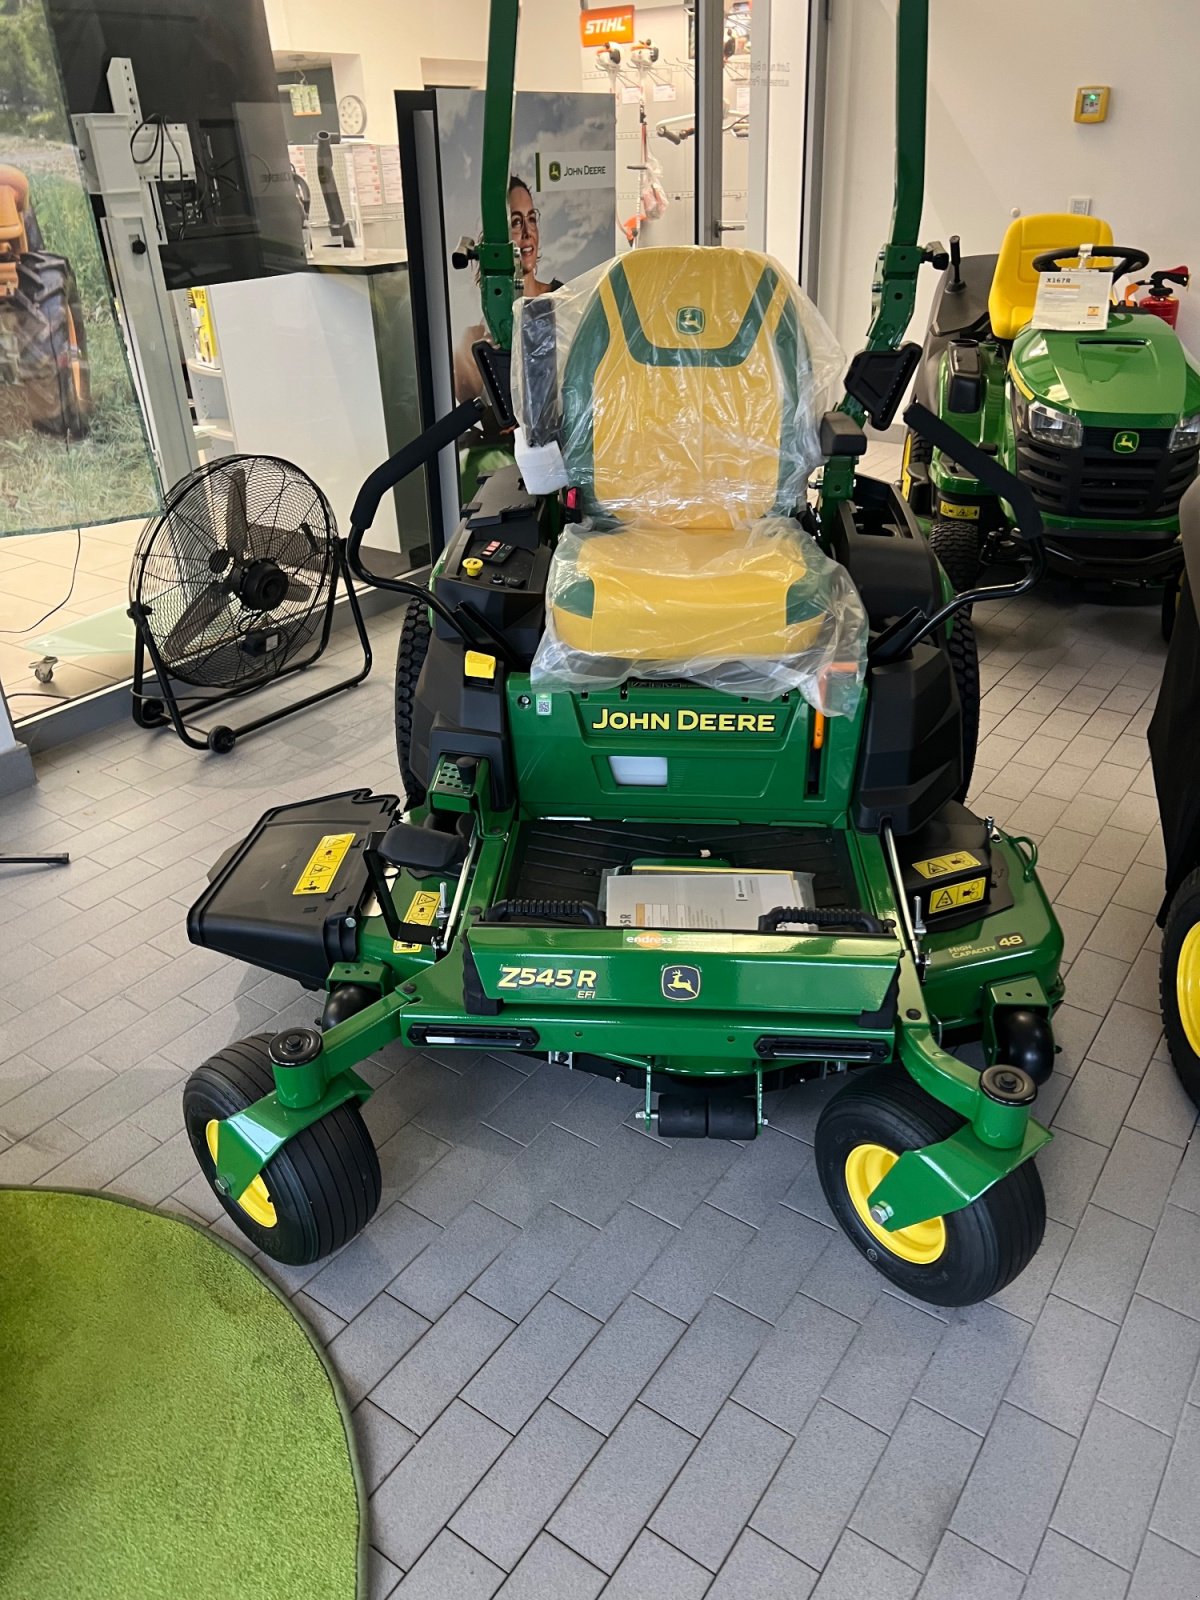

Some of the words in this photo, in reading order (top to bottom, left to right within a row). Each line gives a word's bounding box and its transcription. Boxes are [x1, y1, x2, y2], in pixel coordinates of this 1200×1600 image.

[584, 16, 626, 35] STIHL
[564, 165, 583, 176] JOHN
[584, 165, 606, 175] DEERE
[592, 708, 670, 731] JOHN
[676, 709, 776, 732] DEERE
[625, 935, 673, 944] endress
[999, 935, 1023, 947] 48
[948, 944, 972, 954] HIGH
[951, 945, 996, 959] CAPACITY
[498, 966, 574, 988] Z545
[576, 969, 597, 989] R
[577, 990, 596, 999] EFI
